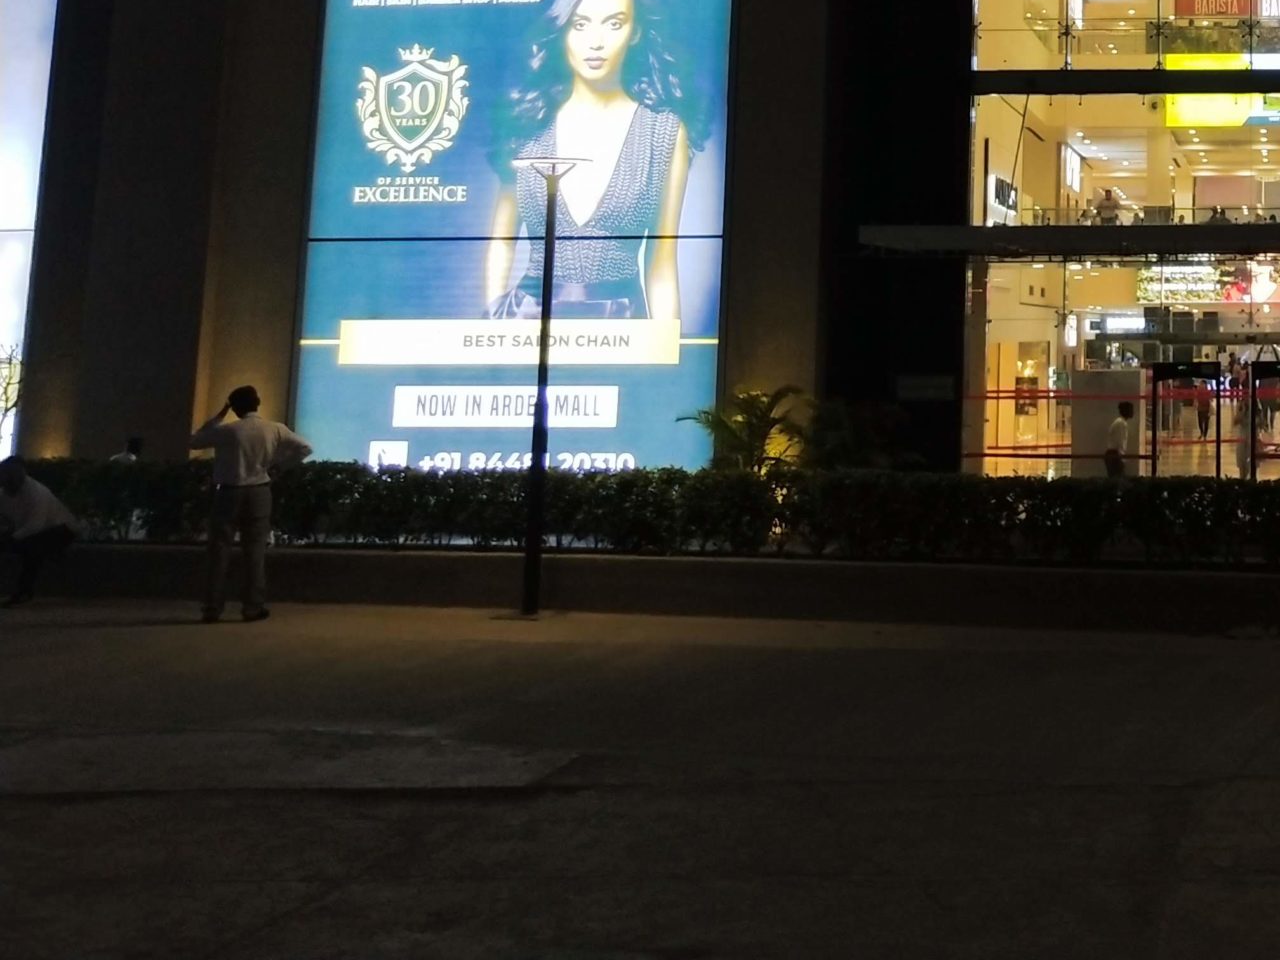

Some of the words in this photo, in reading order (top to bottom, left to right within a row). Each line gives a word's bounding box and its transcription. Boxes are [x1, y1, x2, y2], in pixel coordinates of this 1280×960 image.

[391, 81, 435, 116] 30
[395, 118, 428, 127] YEARS
[377, 176, 391, 185] OF
[395, 176, 440, 185] SERVICE
[353, 186, 468, 202] EXCELLENCE
[462, 334, 506, 348] BEST
[575, 334, 631, 348] CHAIN
[416, 395, 457, 416] NOW
[465, 395, 482, 416] IN
[490, 394, 541, 416] ARDE
[554, 395, 600, 416] MALL
